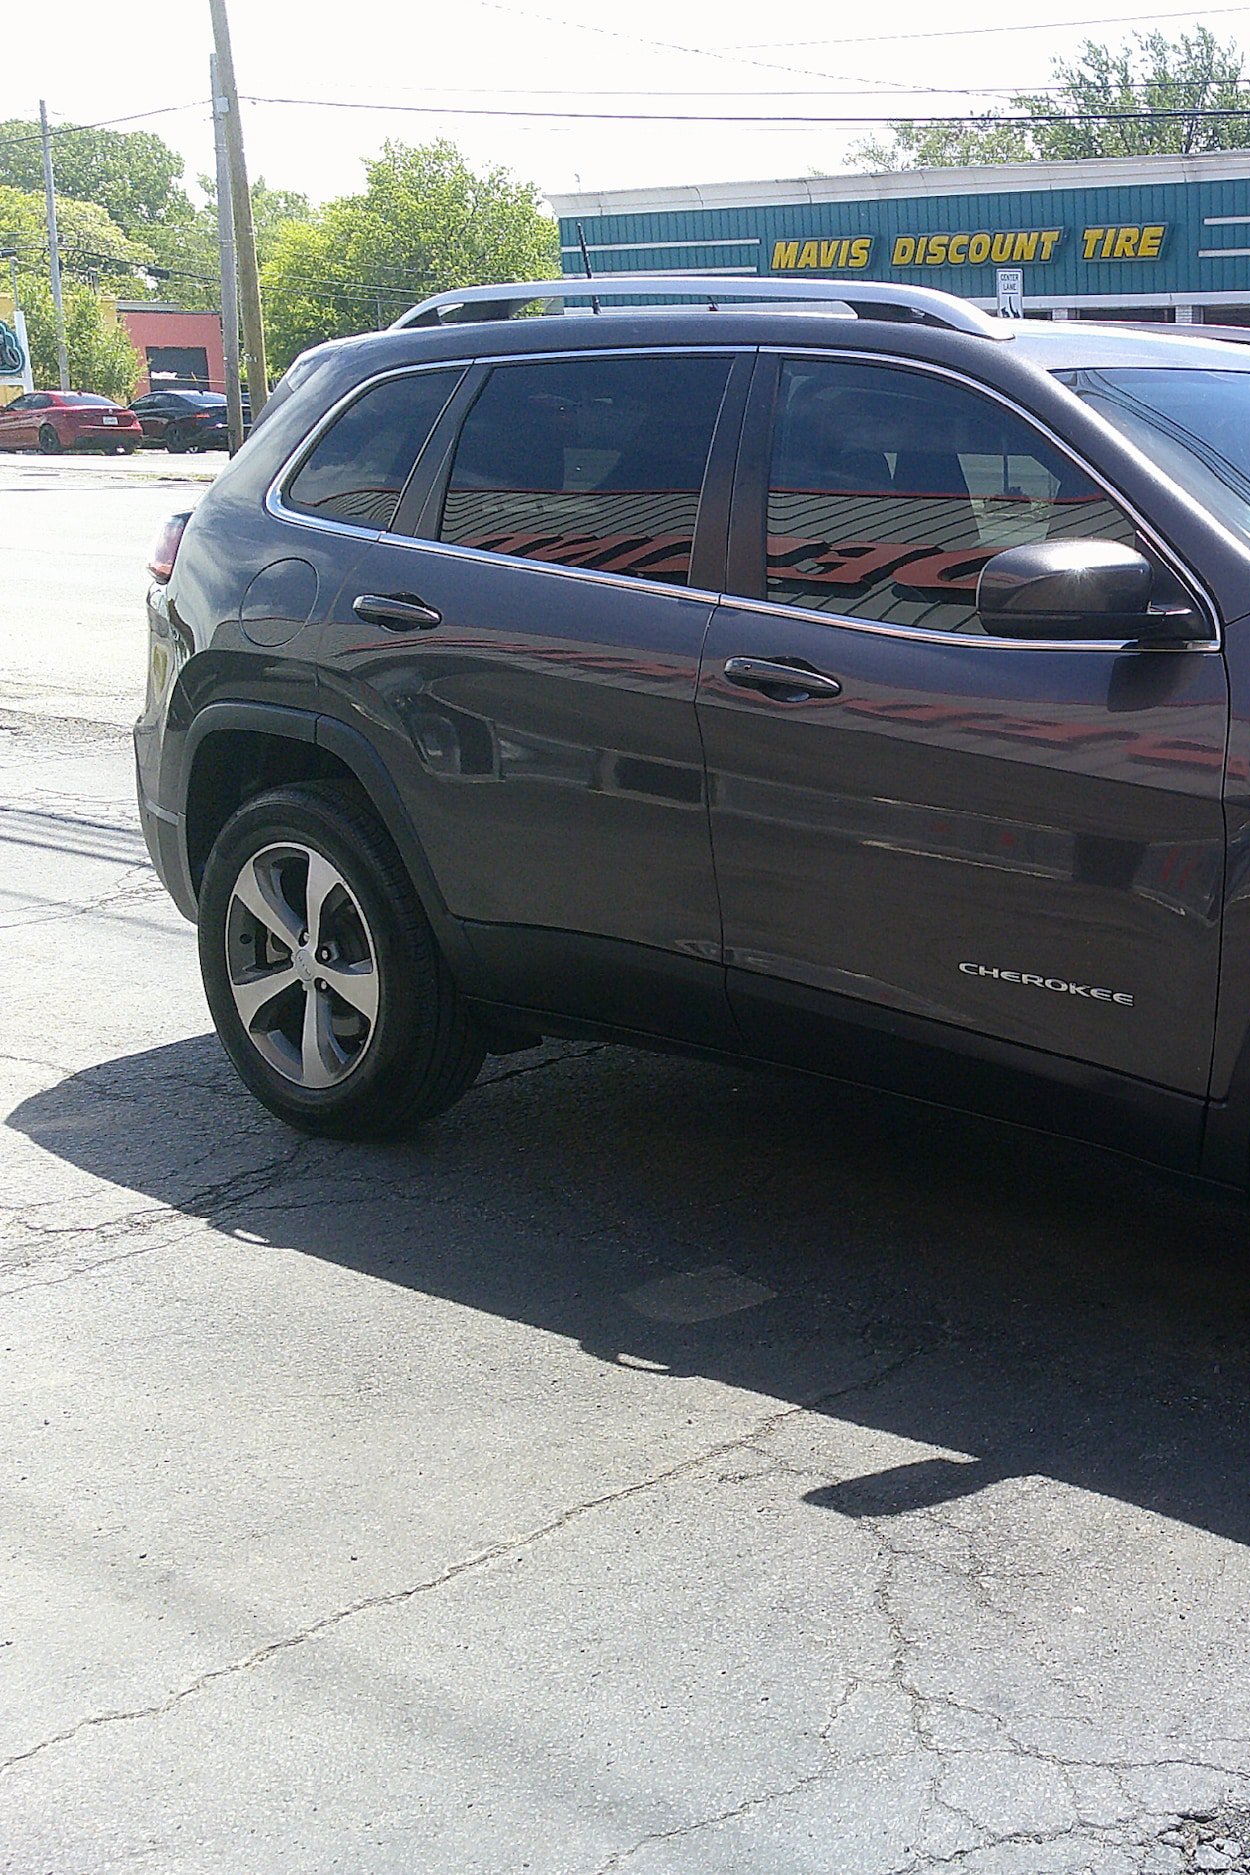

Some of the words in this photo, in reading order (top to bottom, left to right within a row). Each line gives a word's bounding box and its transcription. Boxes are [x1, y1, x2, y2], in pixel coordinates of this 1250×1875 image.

[772, 239, 871, 269] MAVIS
[893, 231, 1060, 265] DISCOUNT
[1083, 227, 1164, 258] TIRE
[1000, 273, 1019, 281] CENTER
[1003, 283, 1017, 291] LANE
[958, 962, 1134, 1007] CHEROKEE
